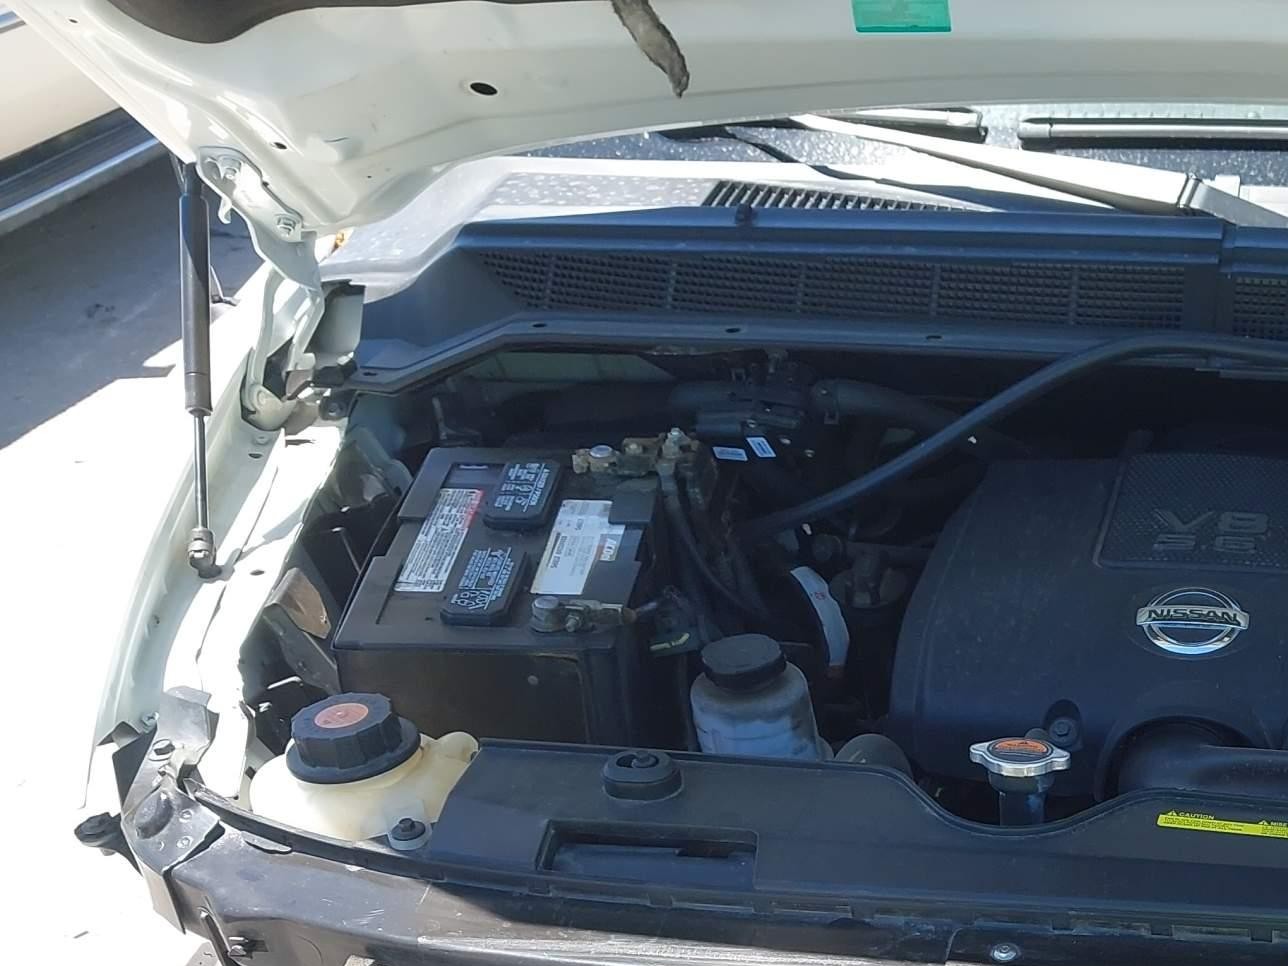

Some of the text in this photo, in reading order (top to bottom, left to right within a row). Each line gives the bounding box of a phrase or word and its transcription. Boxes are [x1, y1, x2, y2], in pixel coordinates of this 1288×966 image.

[1153, 508, 1270, 534] V8
[1147, 607, 1241, 626] NISSAN
[1179, 811, 1215, 820] CAUTION
